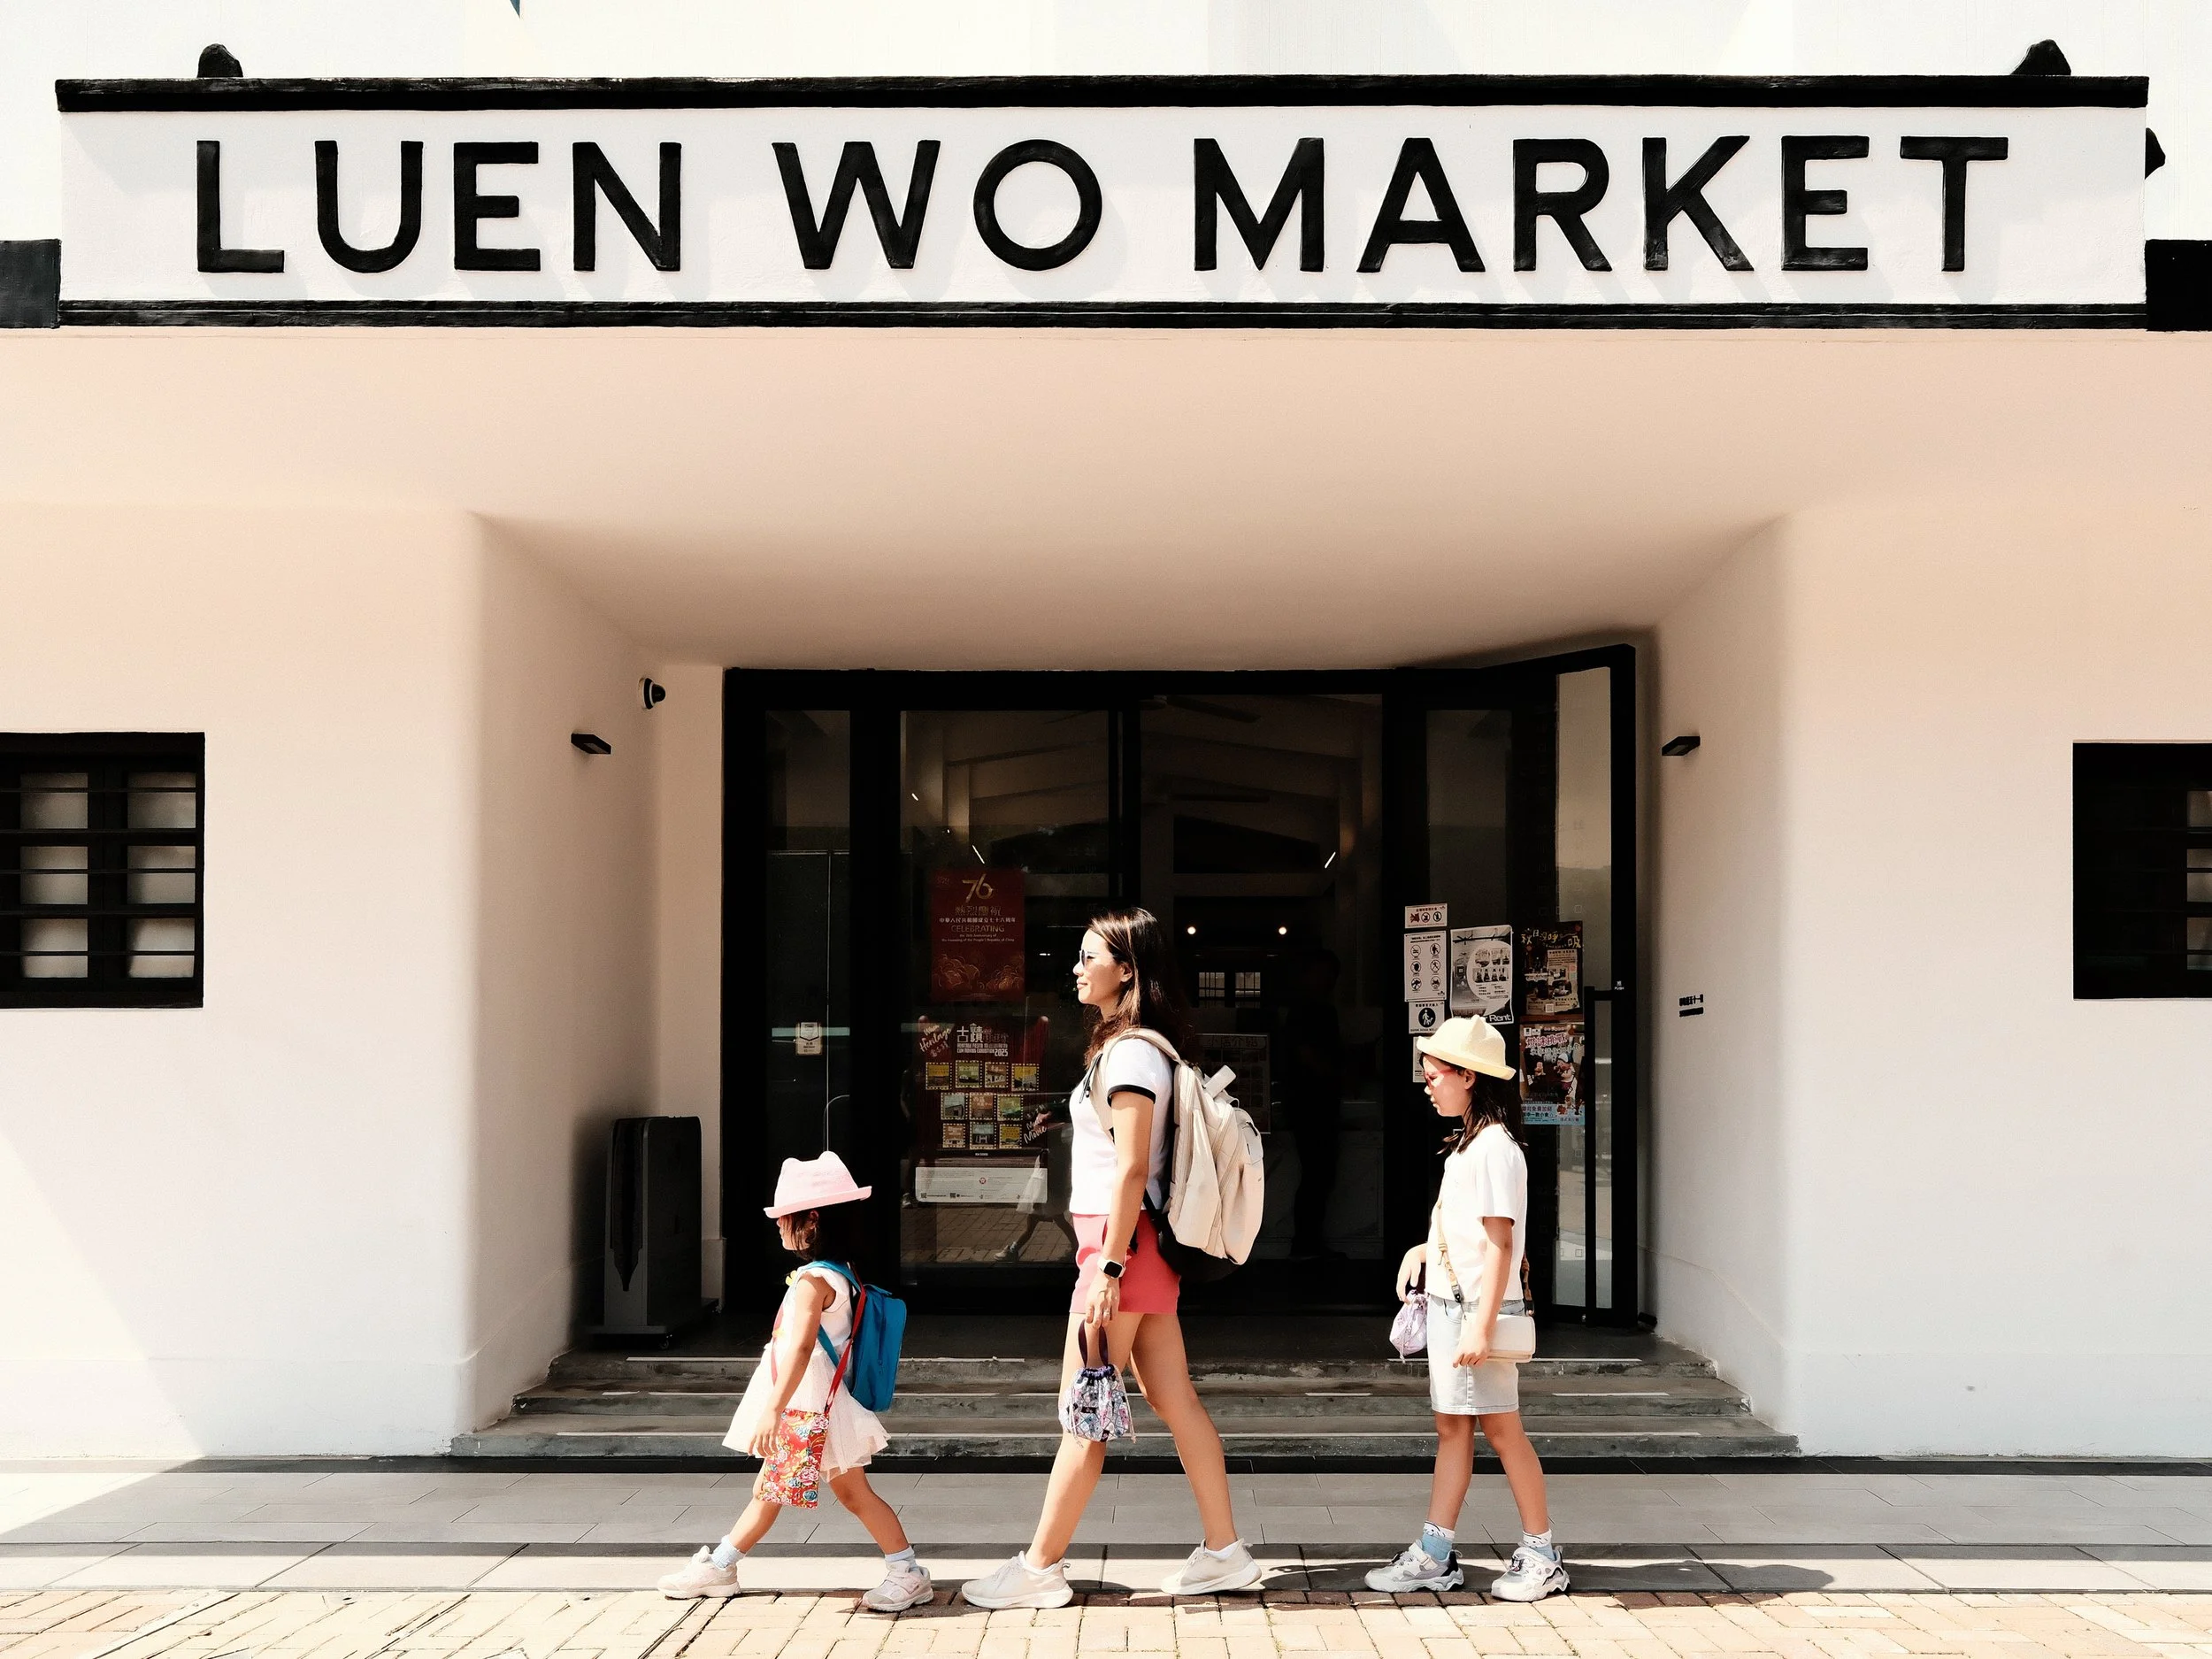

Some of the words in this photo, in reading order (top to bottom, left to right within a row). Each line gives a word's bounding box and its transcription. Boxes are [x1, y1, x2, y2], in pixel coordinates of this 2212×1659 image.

[196, 140, 682, 273] LUEN
[772, 138, 1102, 272] WO
[1193, 134, 2009, 273] MARKET
[962, 873, 995, 902] 76
[919, 1026, 953, 1053] Heritage
[1023, 1125, 1048, 1145] Movie
